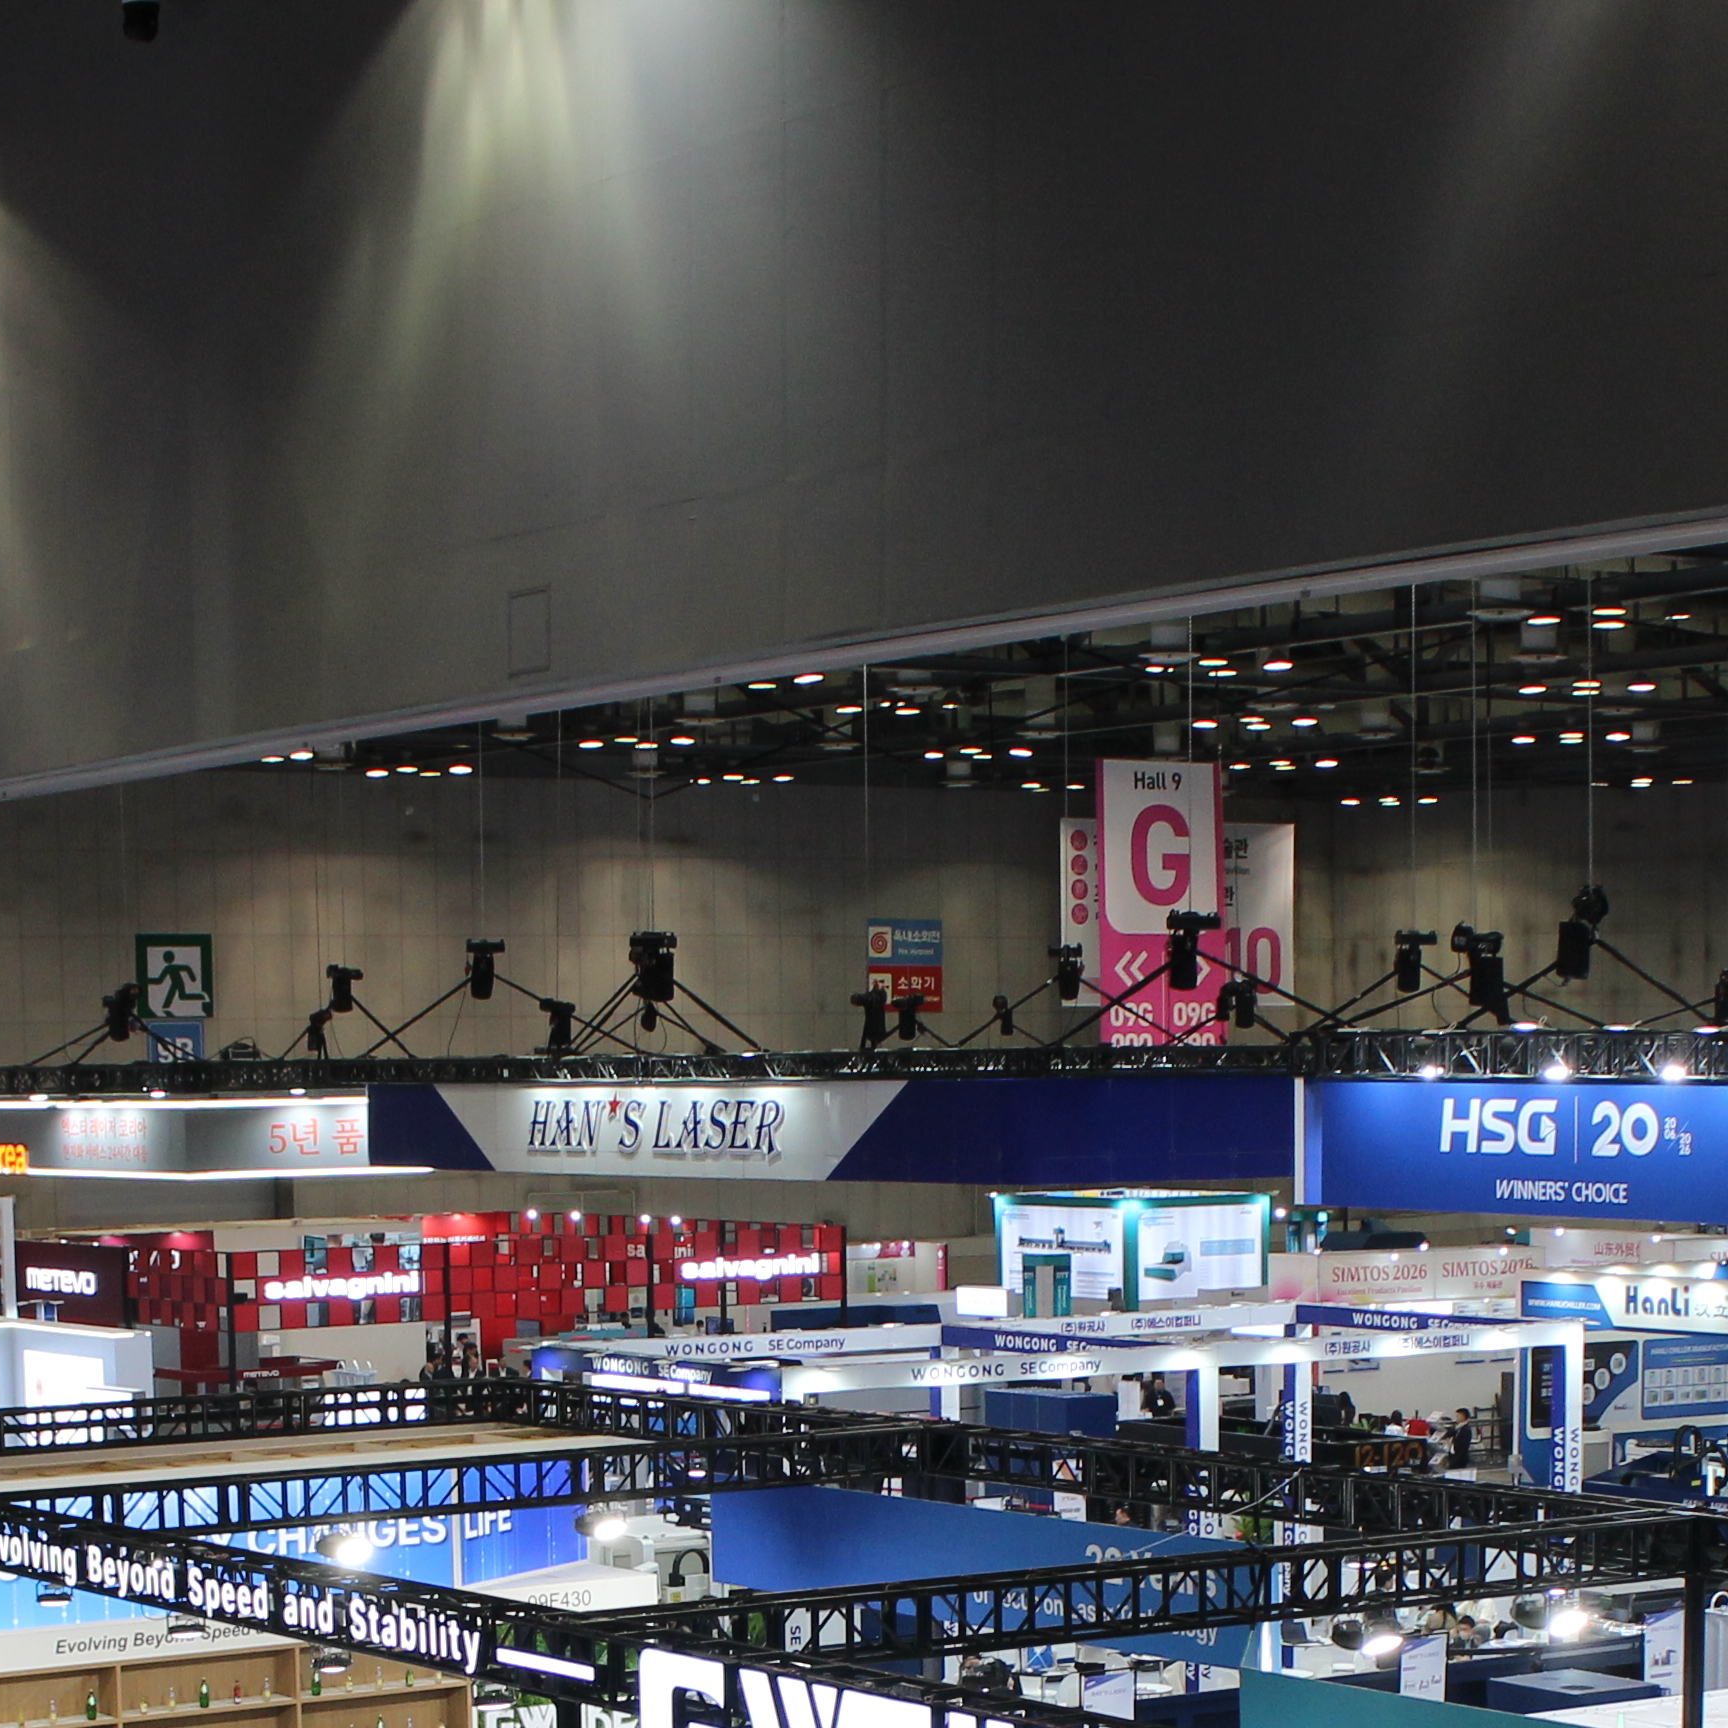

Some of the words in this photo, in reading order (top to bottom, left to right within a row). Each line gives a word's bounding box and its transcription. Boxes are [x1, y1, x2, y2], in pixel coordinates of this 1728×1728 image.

[1132, 770, 1166, 791] Hall
[1170, 771, 1182, 791] 9
[1131, 804, 1191, 906] G
[1225, 926, 1281, 994] 10
[1109, 1002, 1154, 1027] 09G
[1173, 1001, 1217, 1027] 09G
[268, 1117, 321, 1156] 5년
[331, 1118, 365, 1155] 품
[651, 1097, 787, 1163] LASER
[1439, 1097, 1559, 1157] HSG
[1590, 1101, 1660, 1158] 20
[1572, 1181, 1629, 1205] CHOICE
[679, 1250, 823, 1282] salvagnini
[1332, 1264, 1390, 1284] SIMTOS
[1392, 1263, 1429, 1281] 2026
[1442, 1259, 1499, 1278] SIMTOS
[263, 1270, 421, 1302] salvagnini
[1624, 1284, 1691, 1317] HanLi
[1352, 1311, 1419, 1330] WONGONG
[664, 1339, 755, 1357] WONGONG
[767, 1338, 785, 1352] SE
[785, 1336, 847, 1353] Company
[994, 1333, 1058, 1353] WONGONG
[1324, 1339, 1372, 1356] (주)원공사
[591, 1356, 650, 1376] WONGONG
[657, 1364, 669, 1379] SE
[669, 1365, 713, 1385] Company
[911, 1362, 1006, 1382] WONGONG
[1020, 1361, 1038, 1375] SE
[1038, 1358, 1103, 1375] Company
[463, 1507, 513, 1540] LIFE
[86, 1540, 176, 1601] Beyond
[187, 1563, 270, 1621] Speed
[282, 1588, 336, 1634] and
[347, 1599, 482, 1677] Stability
[527, 1587, 592, 1610] 09F430
[55, 1631, 129, 1656] Evolving
